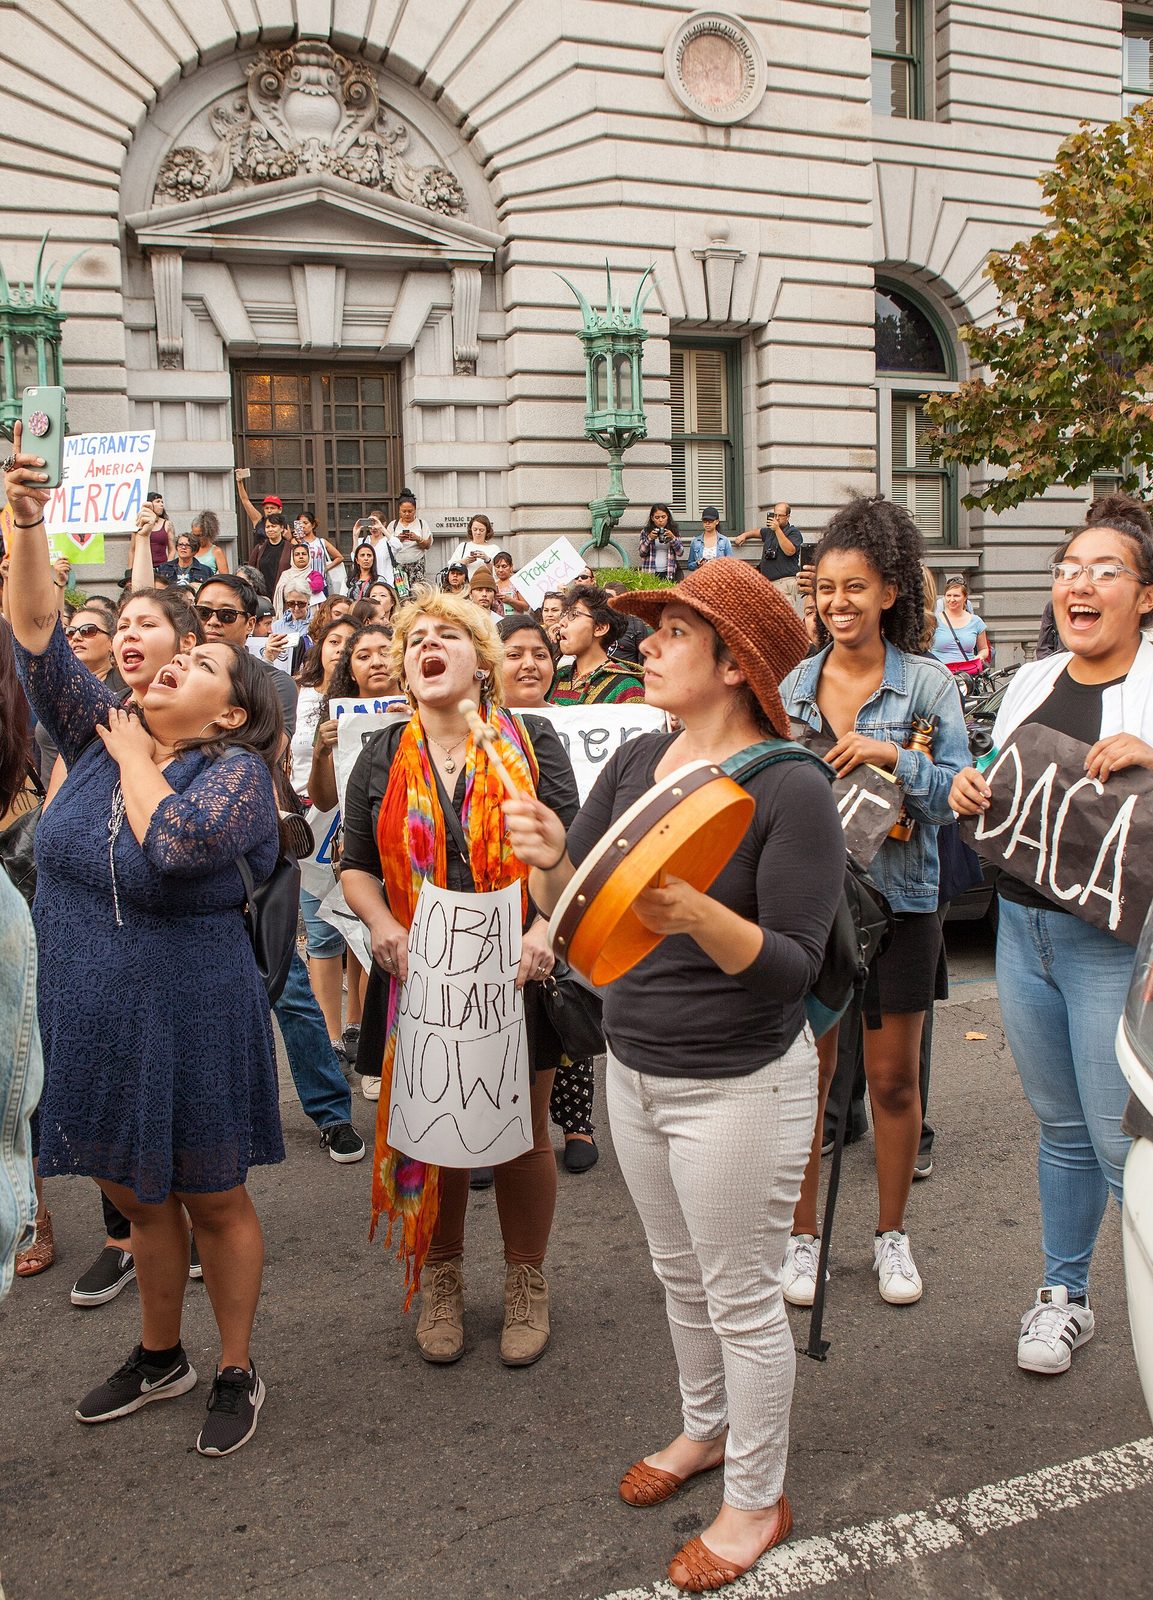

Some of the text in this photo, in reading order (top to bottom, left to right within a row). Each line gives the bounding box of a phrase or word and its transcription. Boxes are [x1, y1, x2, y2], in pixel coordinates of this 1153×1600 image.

[85, 459, 144, 478] AMERICA
[44, 479, 141, 524] MERICA
[518, 549, 561, 587] Protect
[537, 561, 575, 593] DACA
[974, 743, 1138, 931] DACA
